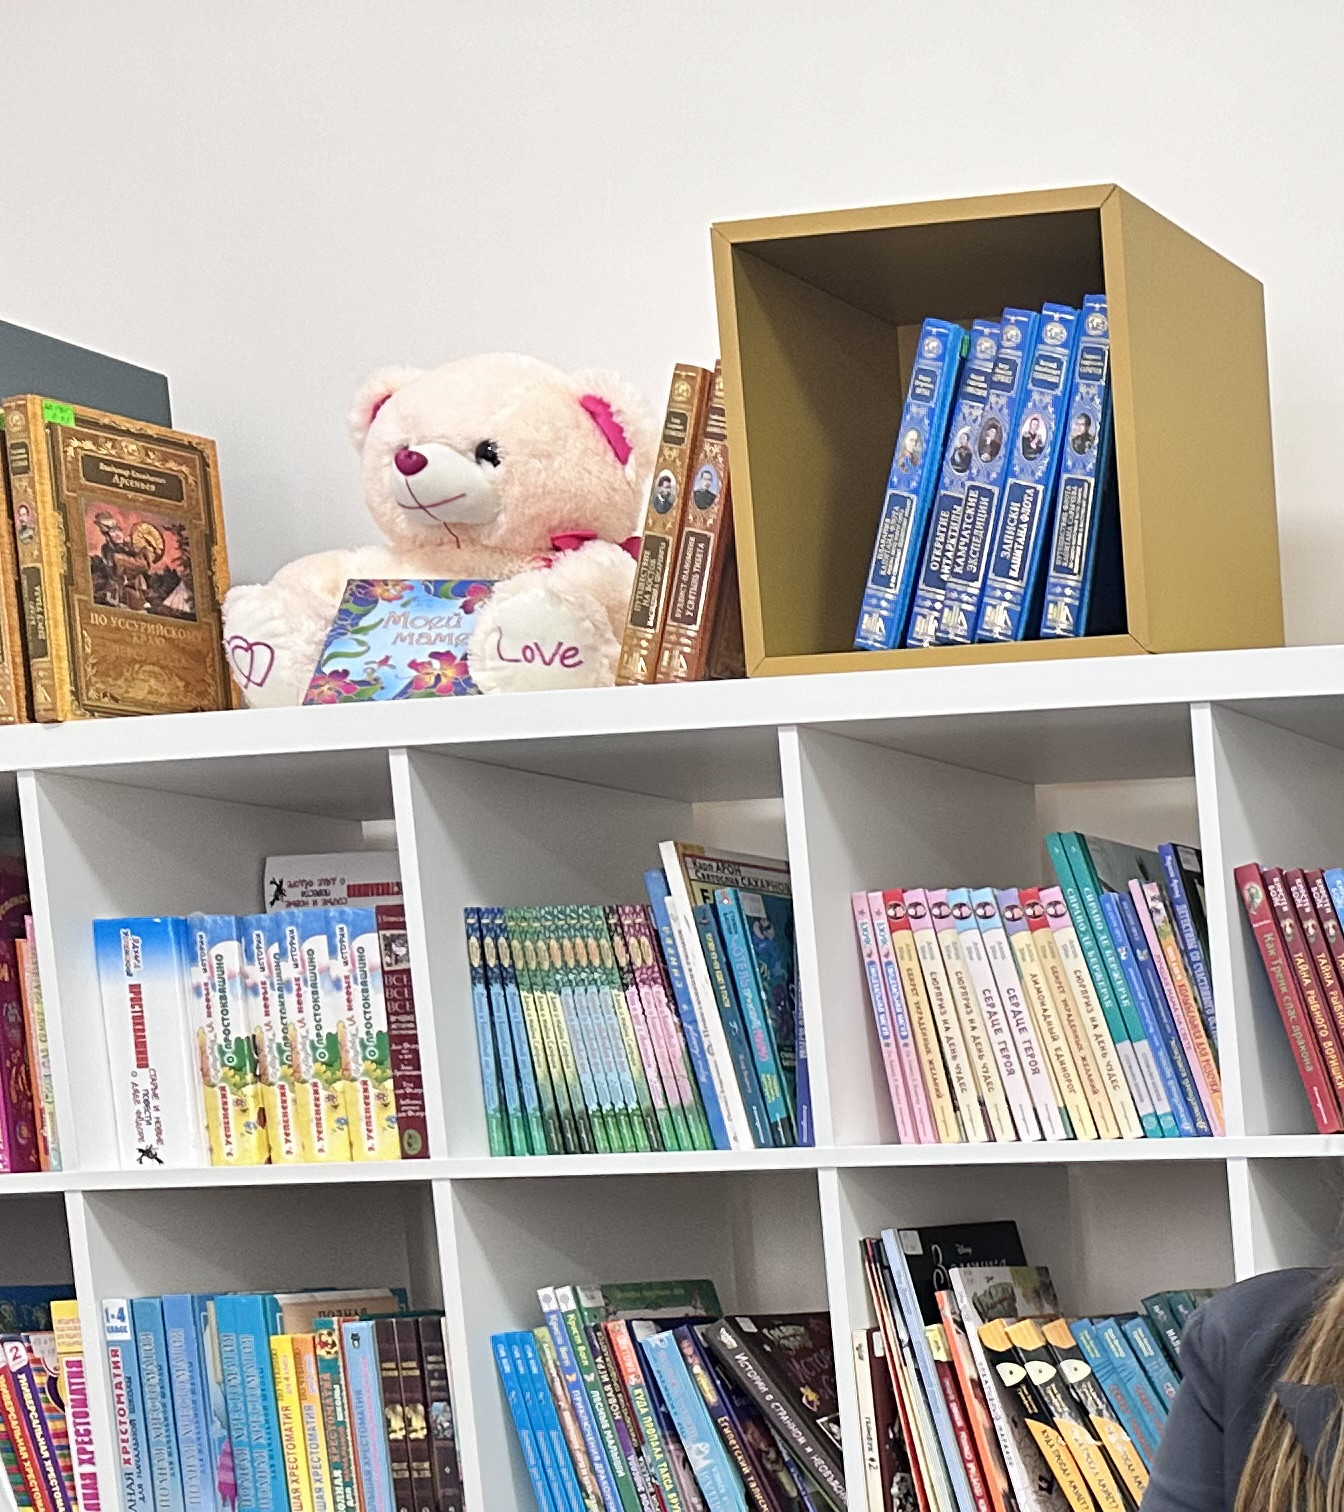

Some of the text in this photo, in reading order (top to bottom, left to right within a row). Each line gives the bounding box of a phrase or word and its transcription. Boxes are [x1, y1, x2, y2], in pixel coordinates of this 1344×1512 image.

[931, 511, 949, 570] ОТКРЫТИЕ
[955, 490, 978, 573] КАМЧАТСКИЕ
[967, 497, 989, 572] ЭКСПЕДИЦИИ
[1001, 503, 1019, 558] ЗАПИСКИ
[90, 614, 107, 627] ПО
[383, 611, 463, 630] Моей
[495, 626, 584, 668] Love
[215, 954, 234, 1050] ПРОСТОКВАШИНО
[1074, 970, 1093, 1013] СЮРПРИЗ
[1263, 933, 1279, 955] Как
[1292, 1026, 1314, 1072] дракона
[1294, 952, 1311, 986] ТАЙНА
[1305, 990, 1328, 1036] РЫБНОГО
[1006, 988, 1040, 1075] СЕРДЦЕ ГЕРОЯ
[1030, 973, 1075, 1095] ЛИМОНАДНЫЙ ЕДИНОРОГ
[1088, 1017, 1099, 1029] НА
[1093, 1033, 1108, 1058] ДЕНЬ
[1104, 1061, 1120, 1091] ЧУДЕС
[64, 1360, 95, 1466] ХРЕСТОМАТИЯ
[634, 1389, 651, 1413] КУДА
[280, 1406, 300, 1485] ХРЕСТОМАТИЯ
[640, 1416, 664, 1459] ПРОПАЛА
[654, 1462, 674, 1490] ТАКСА
